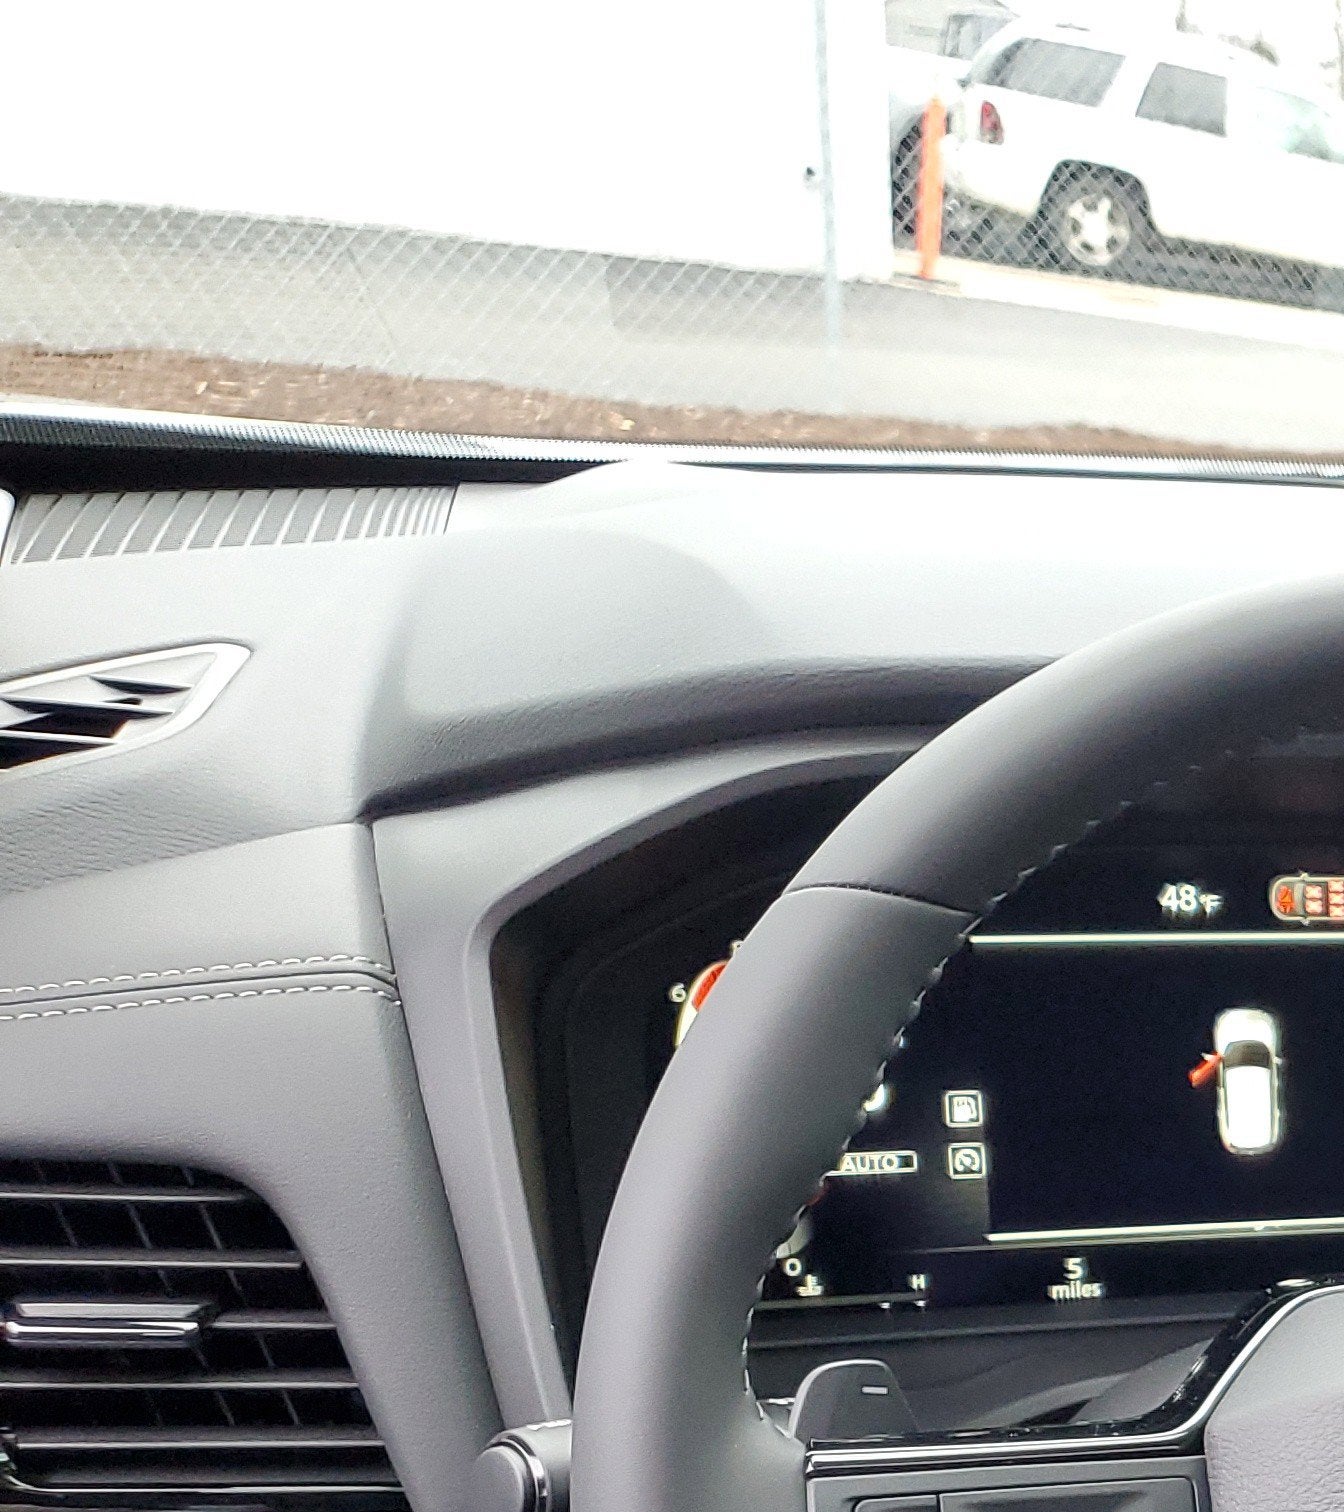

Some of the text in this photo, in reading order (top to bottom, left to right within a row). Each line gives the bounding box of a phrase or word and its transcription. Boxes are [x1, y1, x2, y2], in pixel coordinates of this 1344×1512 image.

[669, 982, 687, 1003] 6
[839, 1153, 900, 1172] AUTO
[1062, 1257, 1084, 1280] 5
[909, 1274, 927, 1289] H
[1047, 1281, 1102, 1301] miles
